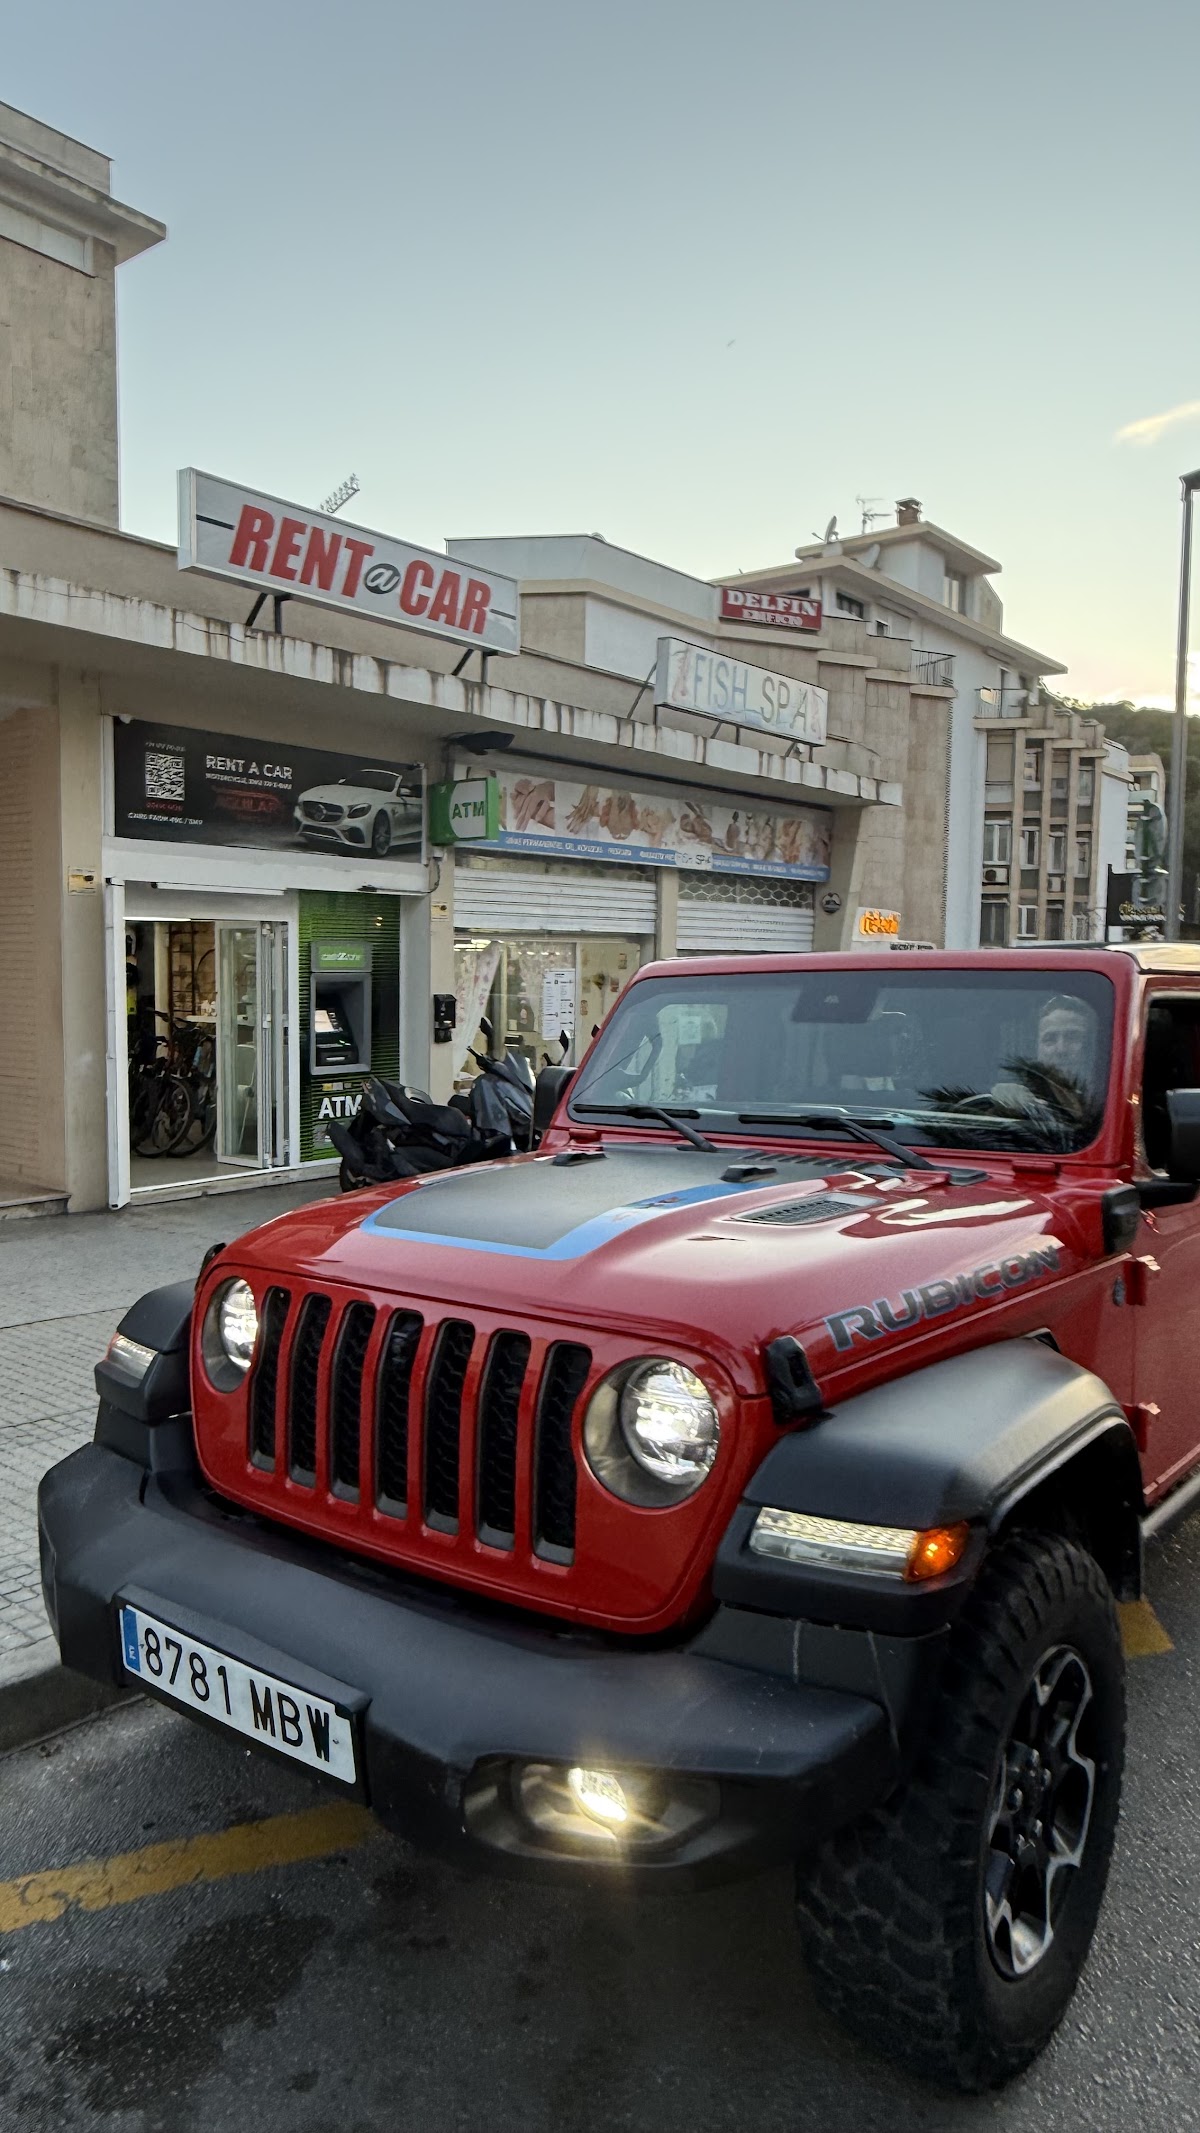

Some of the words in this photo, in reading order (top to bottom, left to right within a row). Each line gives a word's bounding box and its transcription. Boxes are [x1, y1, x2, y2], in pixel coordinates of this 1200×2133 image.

[228, 503, 375, 598] RENT
[400, 559, 492, 635] CAR
[726, 589, 819, 617] DELFIN
[693, 652, 749, 718] FISH
[760, 675, 809, 734] SPA
[206, 755, 246, 773] RENT
[248, 761, 260, 776] A
[263, 764, 293, 780] CAR
[452, 801, 485, 819] ATM
[318, 1094, 363, 1120] ATM
[823, 1244, 1062, 1352] RUBICON
[144, 1627, 232, 1716] 8781
[249, 1678, 330, 1763] MBW
